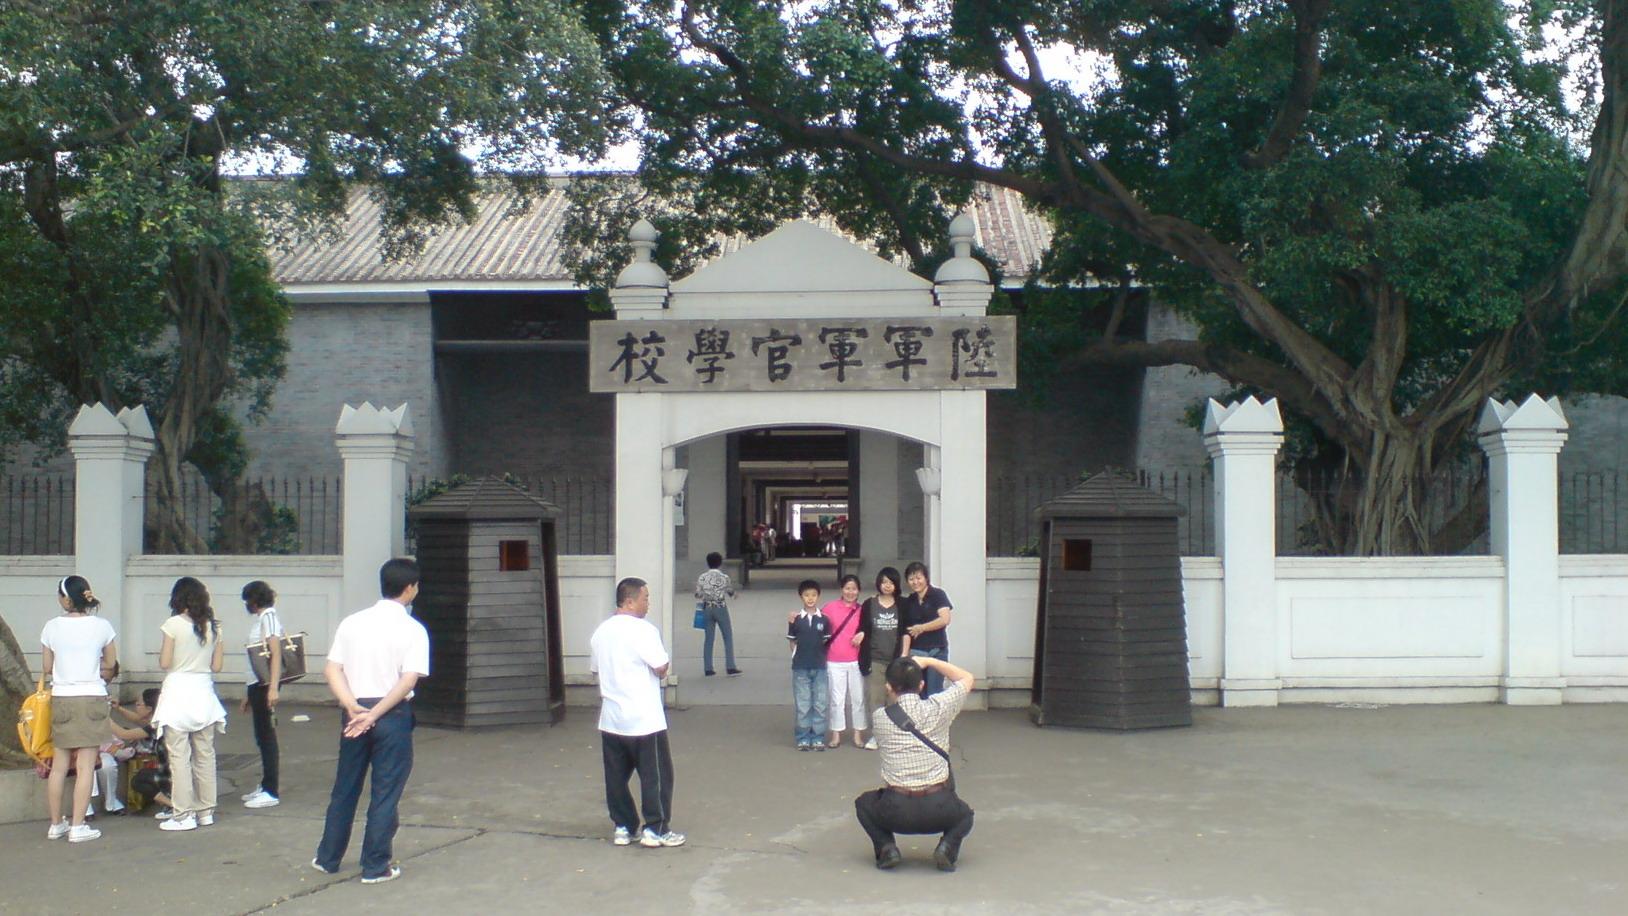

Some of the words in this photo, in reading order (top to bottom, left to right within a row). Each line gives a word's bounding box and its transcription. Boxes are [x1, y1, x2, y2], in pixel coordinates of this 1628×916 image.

[609, 325, 997, 384] 陸軍軍官學校
